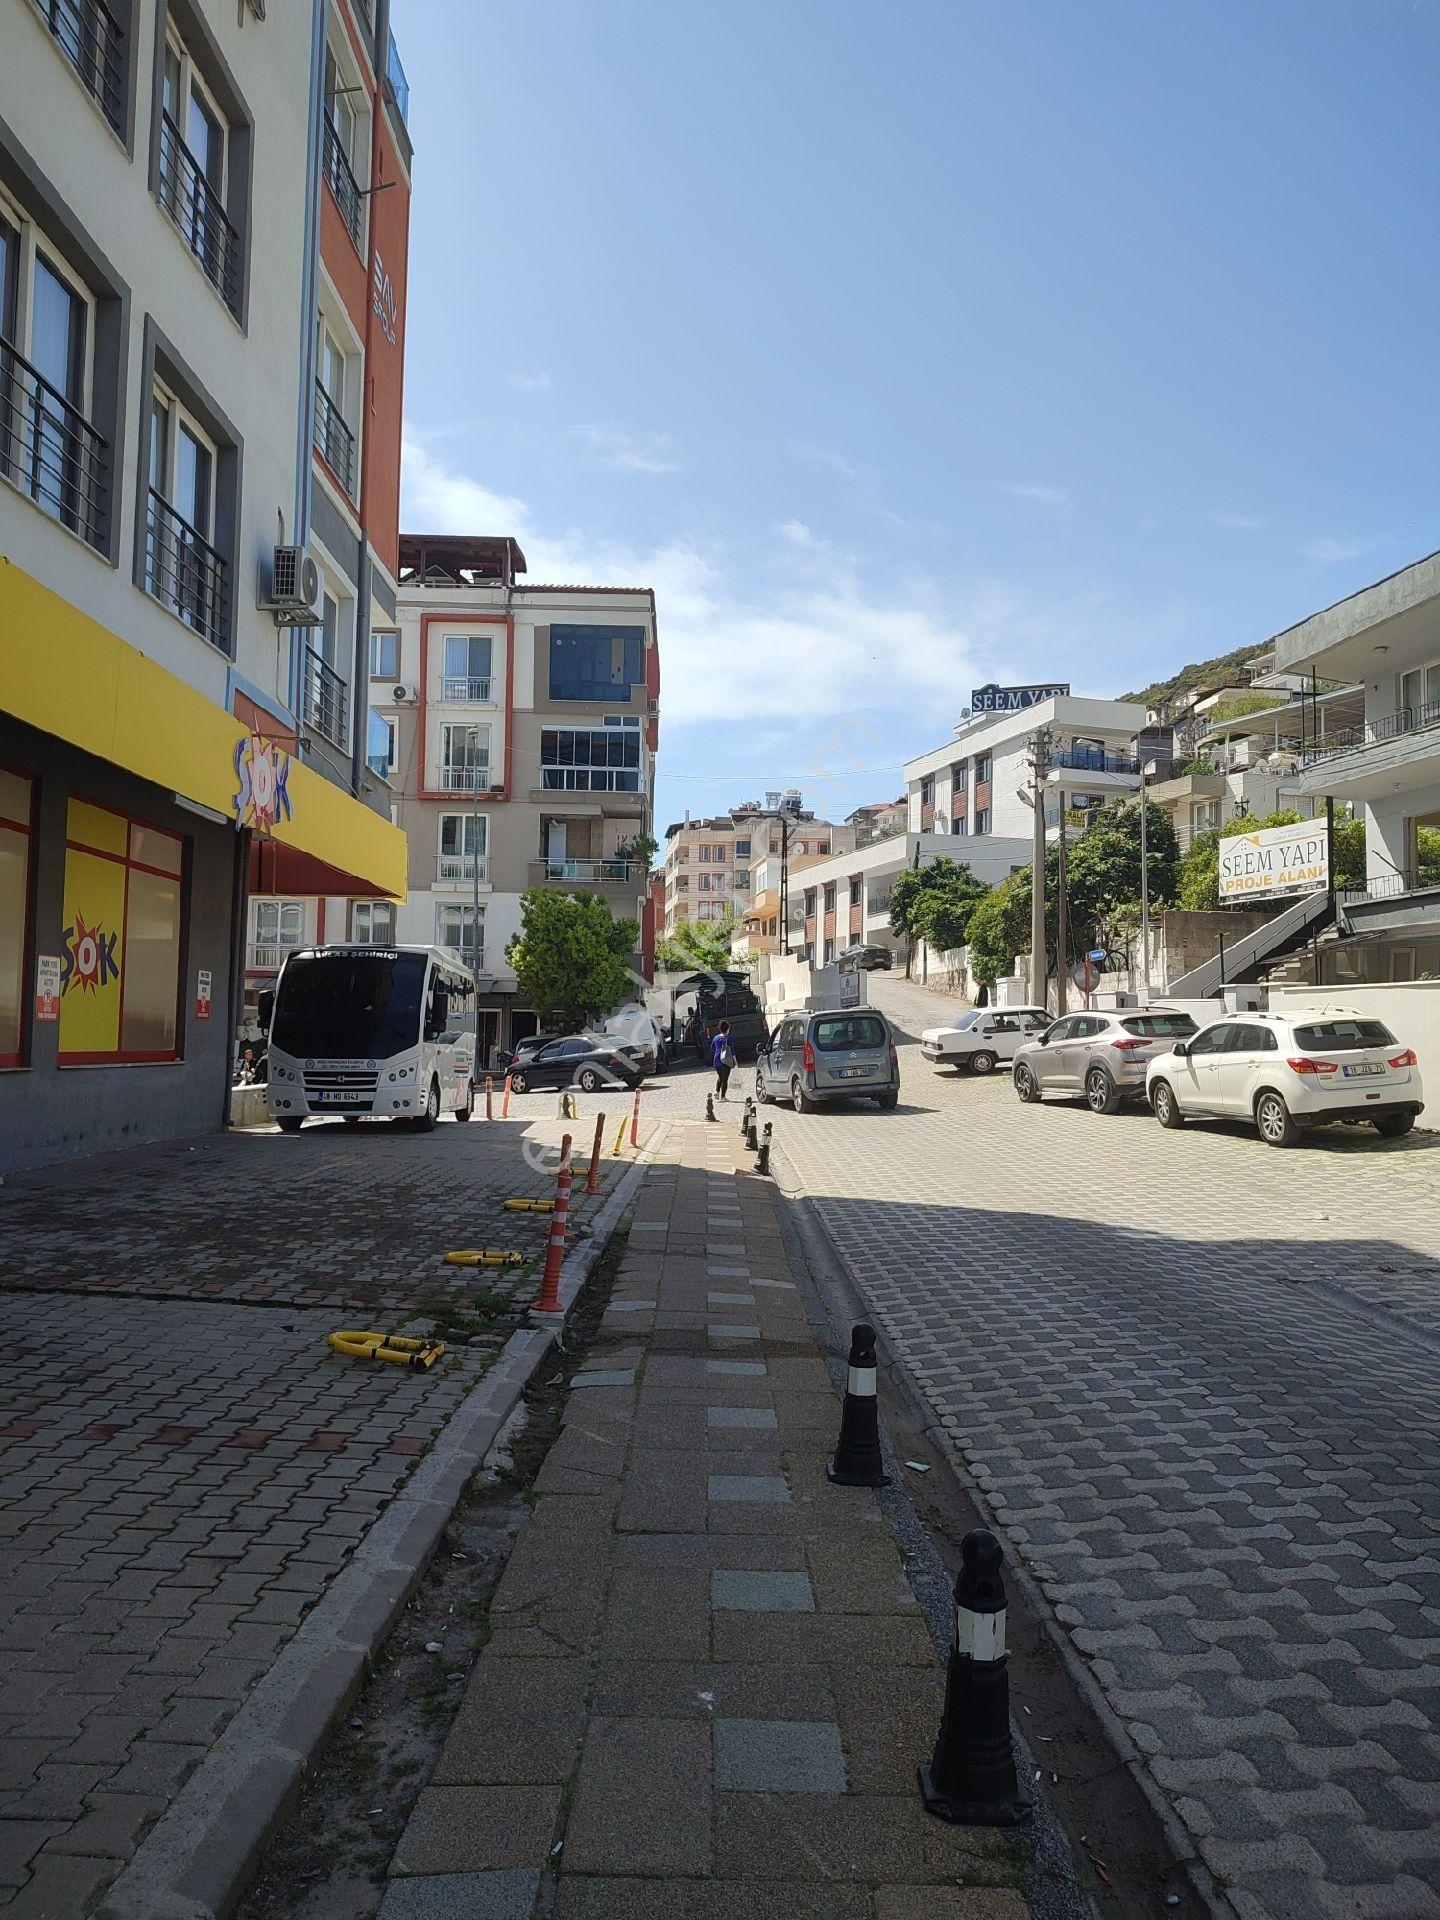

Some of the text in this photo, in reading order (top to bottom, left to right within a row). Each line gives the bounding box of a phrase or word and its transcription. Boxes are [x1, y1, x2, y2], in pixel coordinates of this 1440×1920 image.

[973, 692, 1023, 710] SEEM
[232, 737, 292, 832] ŞOK
[1222, 839, 1325, 878] SEEM YAPI
[1225, 874, 1272, 892] PROJE
[1277, 864, 1324, 885] ALANI
[60, 926, 119, 997] ŞOK
